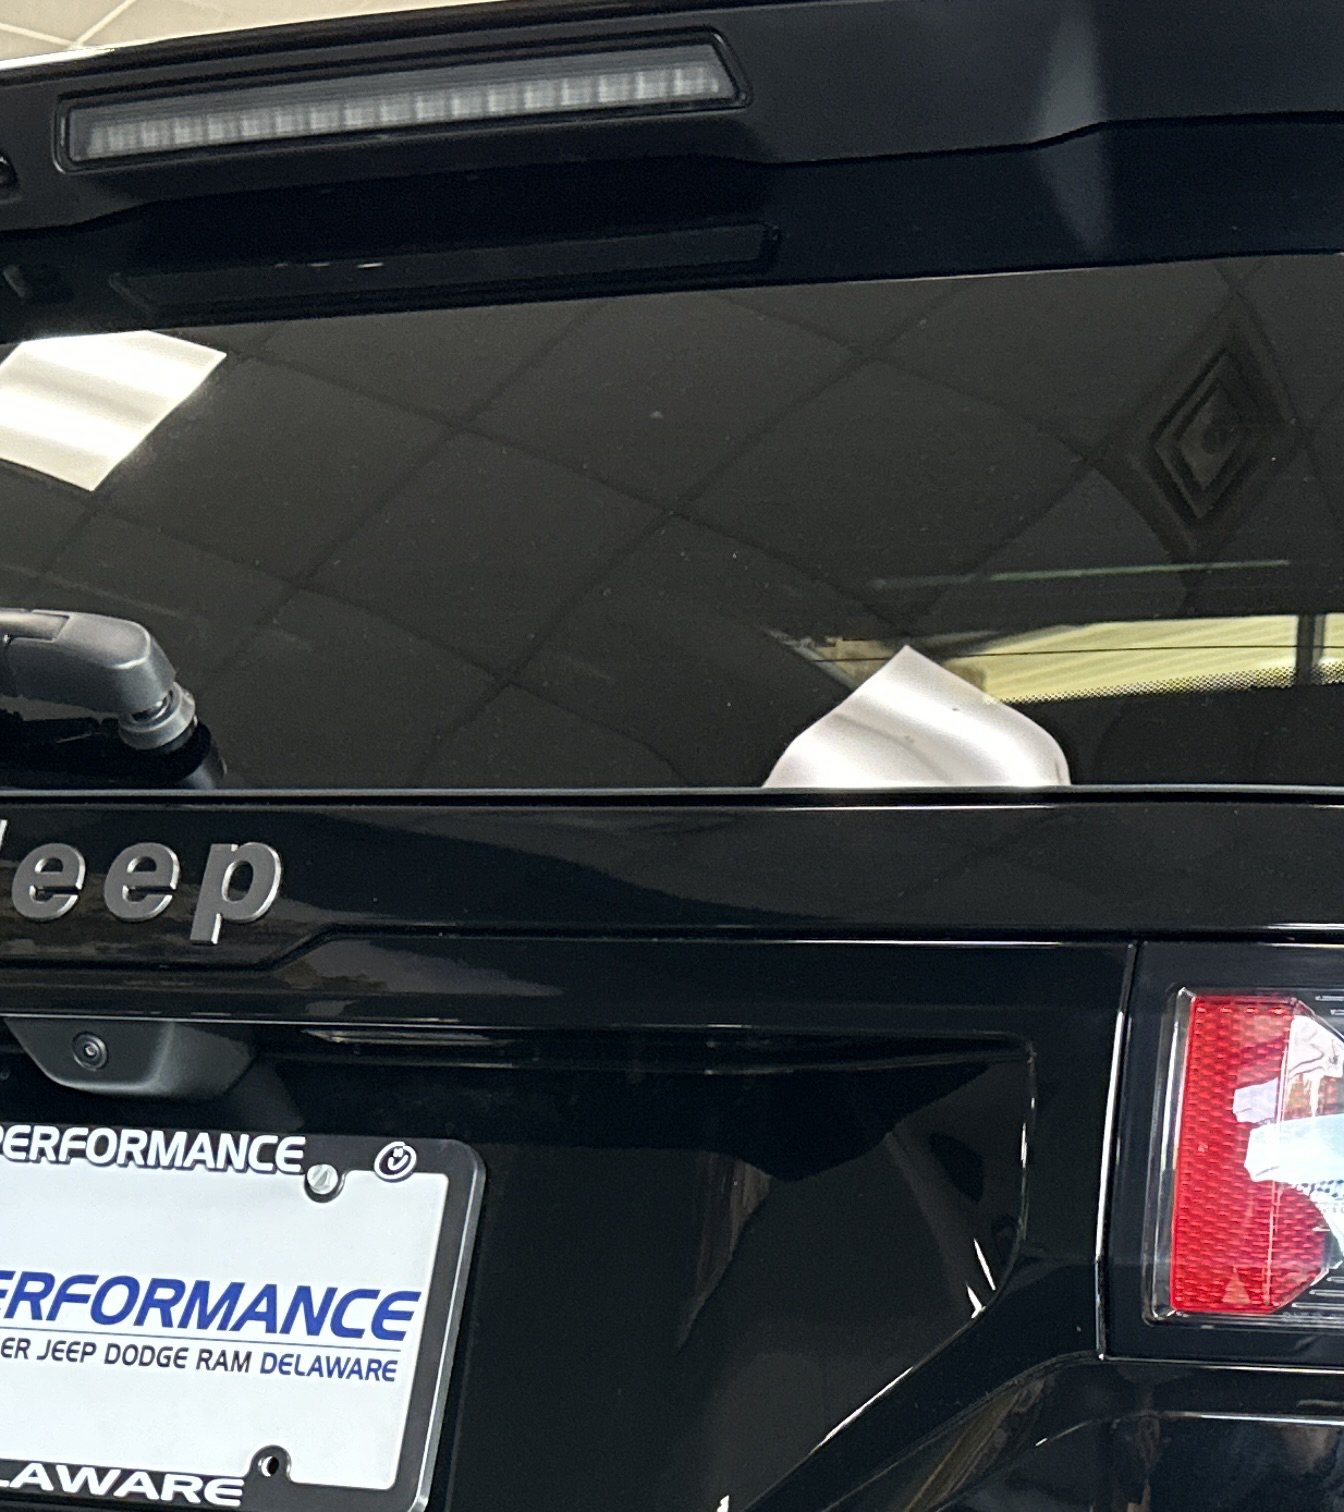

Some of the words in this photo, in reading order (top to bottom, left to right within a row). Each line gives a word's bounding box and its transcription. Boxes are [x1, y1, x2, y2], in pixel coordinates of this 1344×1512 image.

[36, 1341, 97, 1364] JEEP
[103, 1344, 189, 1370] DODGE
[195, 1349, 253, 1374] RAM
[259, 1352, 399, 1383] DELAWARE
